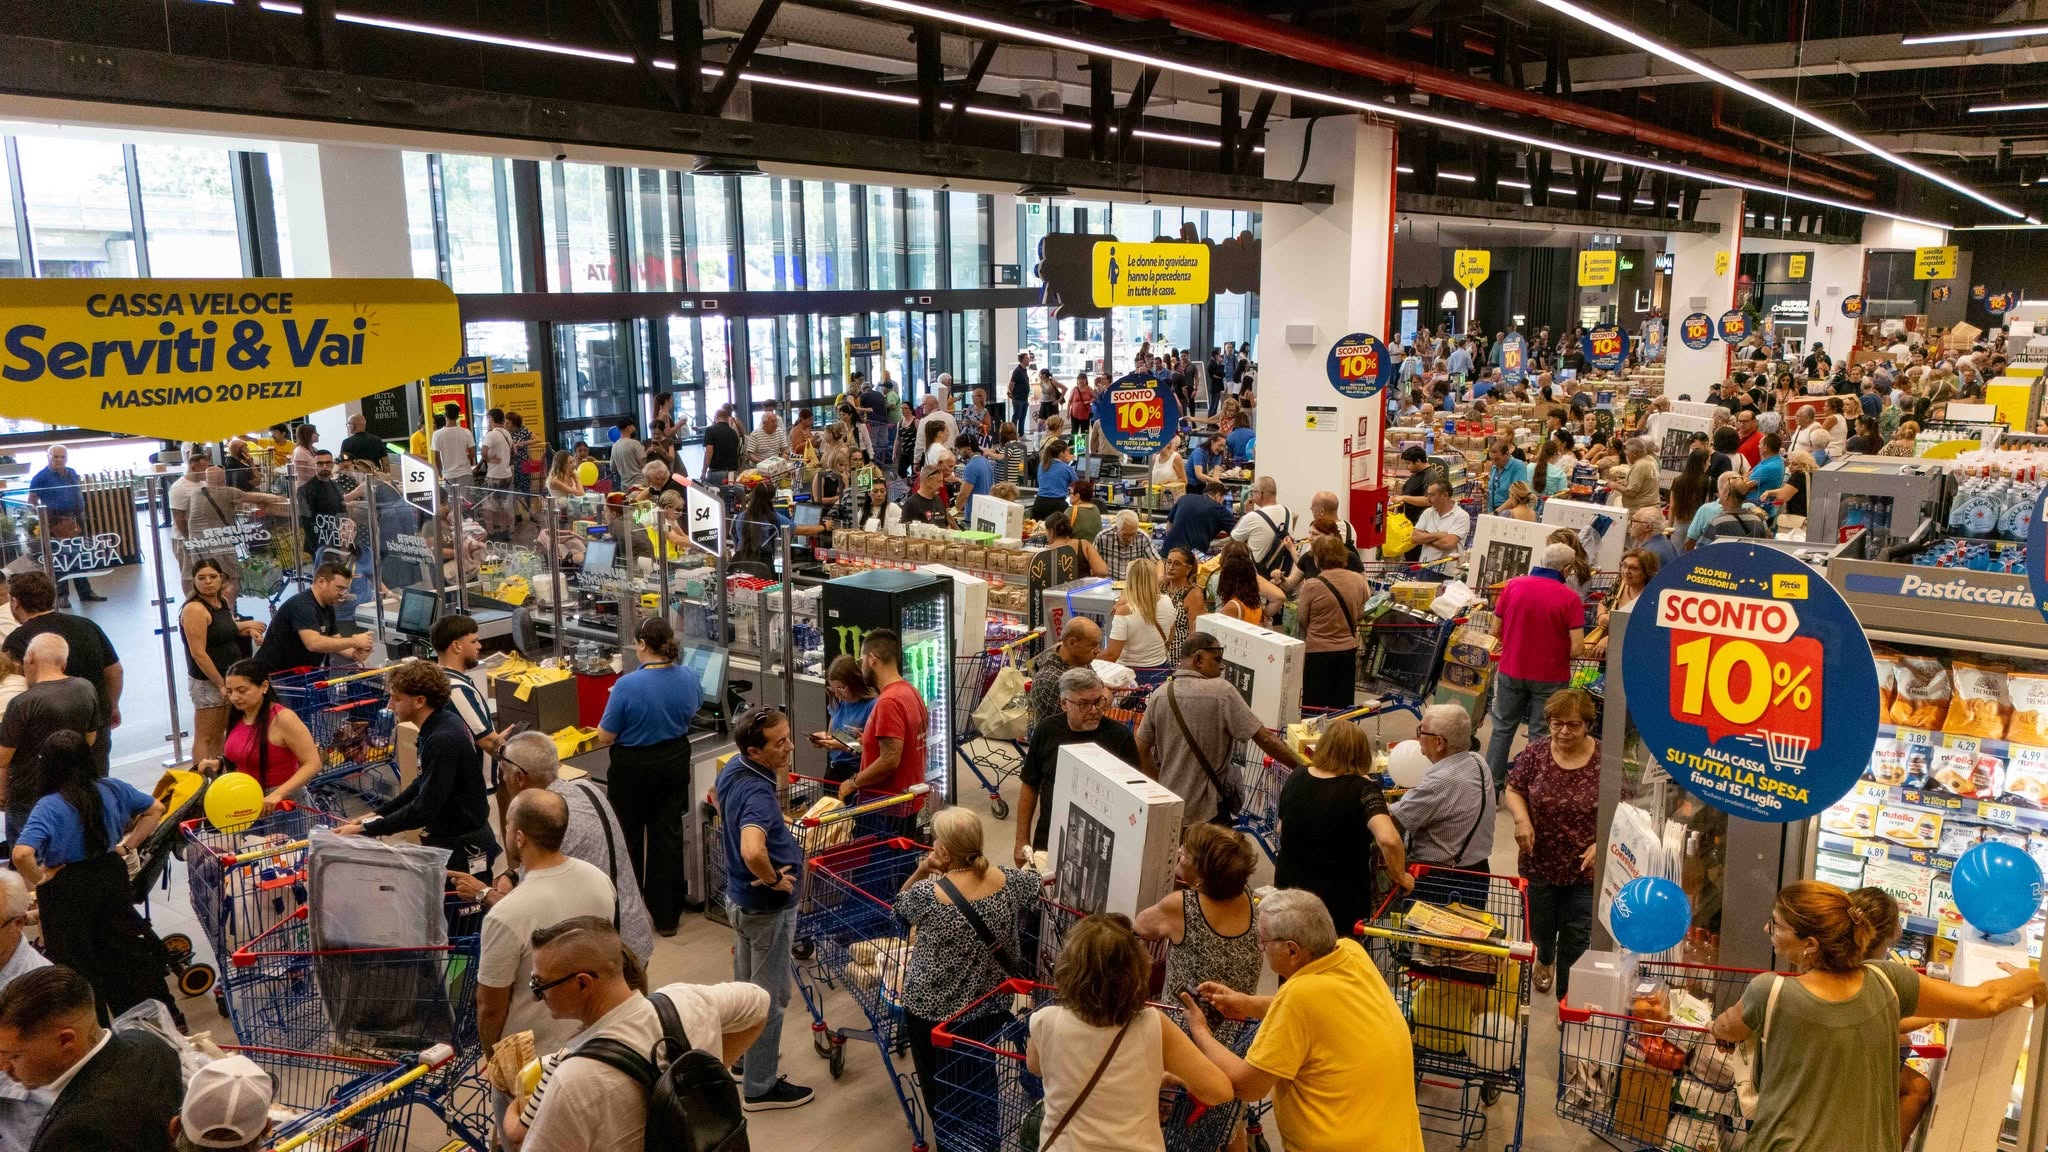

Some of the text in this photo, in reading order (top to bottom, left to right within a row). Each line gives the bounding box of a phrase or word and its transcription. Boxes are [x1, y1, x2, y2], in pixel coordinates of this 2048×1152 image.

[1127, 254, 1198, 270] Le donne in gravidanza
[1127, 269, 1192, 284] hanno la precedenza
[1127, 285, 1177, 297] in tutte le casse.
[87, 293, 293, 318] CASSA VELOCE
[2, 317, 368, 383] Serviti & Vai
[1337, 346, 1370, 355] SCONTO
[1593, 339, 1621, 354] 10%
[1341, 355, 1377, 377] 10%
[100, 380, 303, 410] MASSIMO 20 PEZZI
[1113, 390, 1153, 401] SCONTO
[1118, 401, 1162, 429] 10%
[409, 471, 426, 483] S5
[695, 506, 710, 521] S4
[1693, 566, 1714, 578] SOLO
[1713, 569, 1730, 580] PER
[1686, 574, 1738, 591] POSSESSORI DI
[1900, 574, 2037, 608] Pasticceria
[1664, 595, 1788, 635] SCONTO
[1675, 635, 1813, 725] 10%
[1908, 733, 1928, 745] 3.89
[1957, 741, 1976, 752] 4.29
[1703, 747, 1767, 775] ALLA CASSA
[2021, 750, 2041, 761] 4.99
[1666, 747, 1686, 765] SU
[1688, 754, 1733, 781] TUTTA
[1734, 769, 1755, 788] LA
[1690, 770, 1783, 810] fino al 15 Luglio
[1868, 787, 1886, 798] 4.49
[1882, 810, 1914, 824] nutella
[1992, 808, 2012, 820] 3.89
[1866, 846, 1885, 858] 4.89
